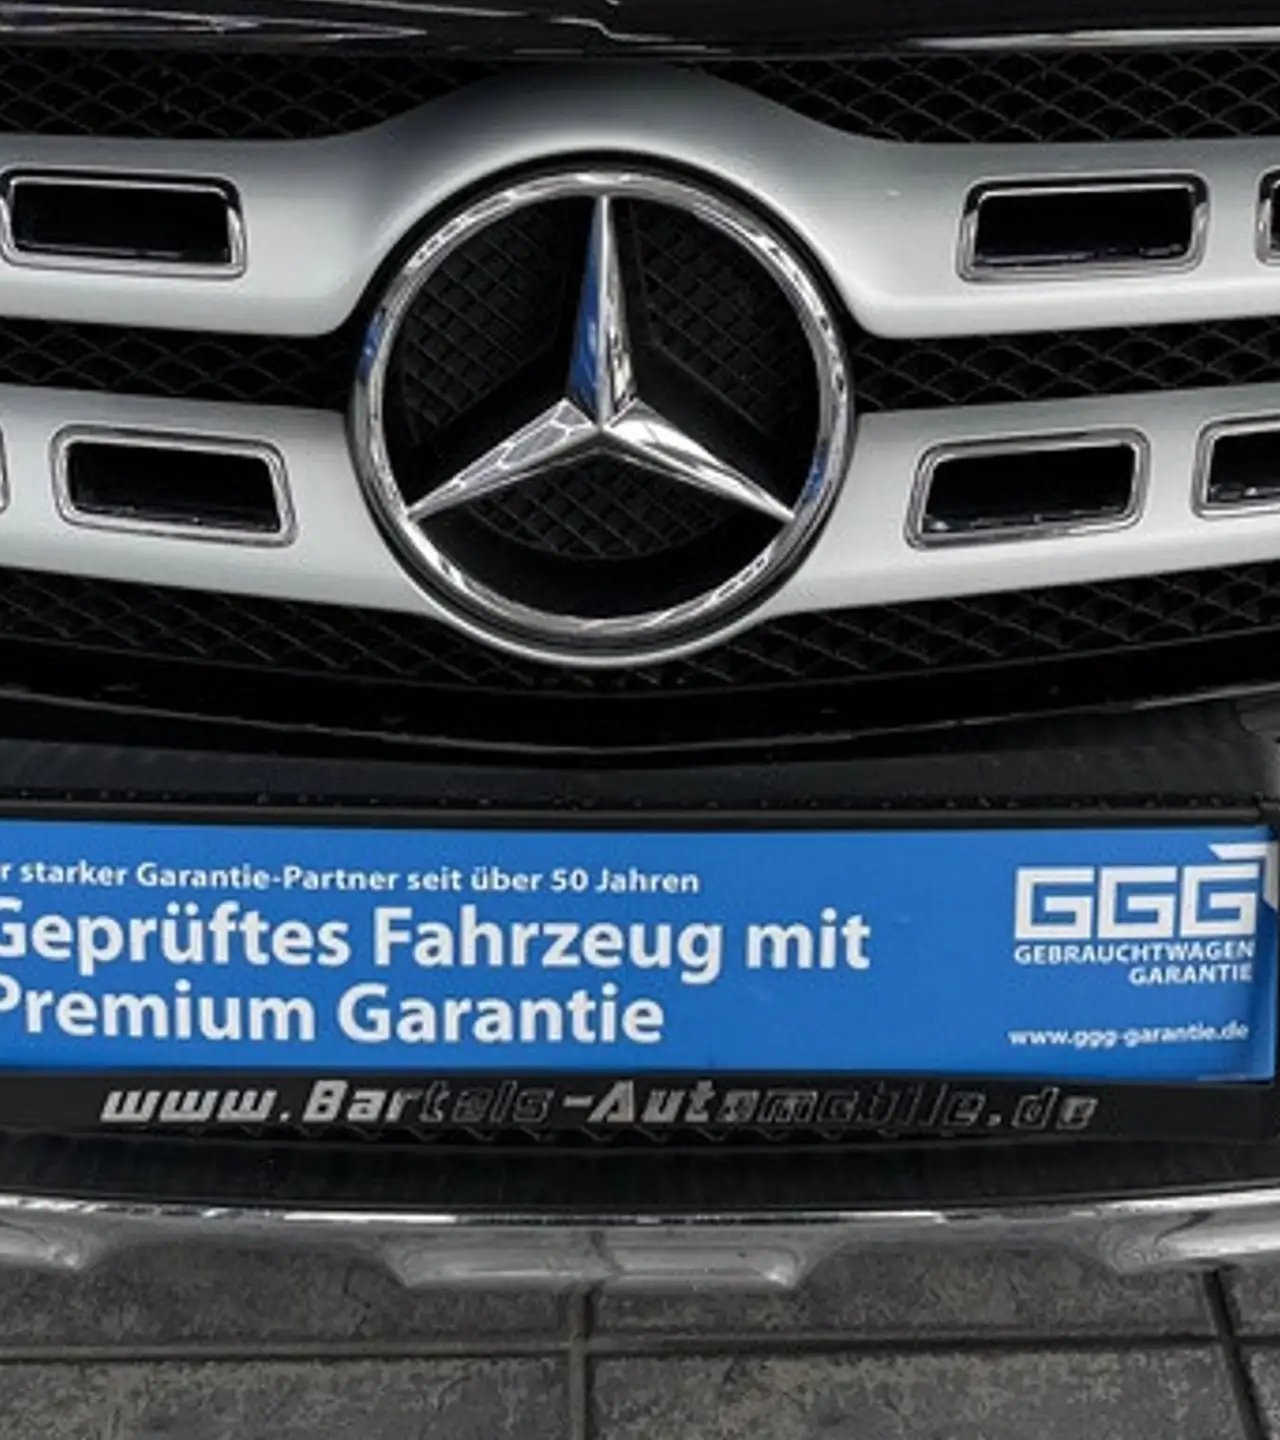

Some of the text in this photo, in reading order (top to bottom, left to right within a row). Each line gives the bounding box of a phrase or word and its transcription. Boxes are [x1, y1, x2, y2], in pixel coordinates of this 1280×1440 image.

[19, 859, 128, 887] starker
[135, 861, 400, 892] Garantie-Partner
[406, 865, 463, 892] seit
[470, 865, 544, 892] über
[550, 867, 589, 893] 50
[594, 867, 700, 894] Jahren
[1014, 862, 1261, 941] GGG
[372, 904, 724, 984] Fahrzeug
[745, 906, 872, 971] mit
[1013, 940, 1256, 965] GEBRAUCHTWAGEN
[1127, 963, 1253, 987] GARANTIE
[336, 981, 665, 1045] Garantie
[1007, 1020, 1250, 1049] www.ggg-garantie.de
